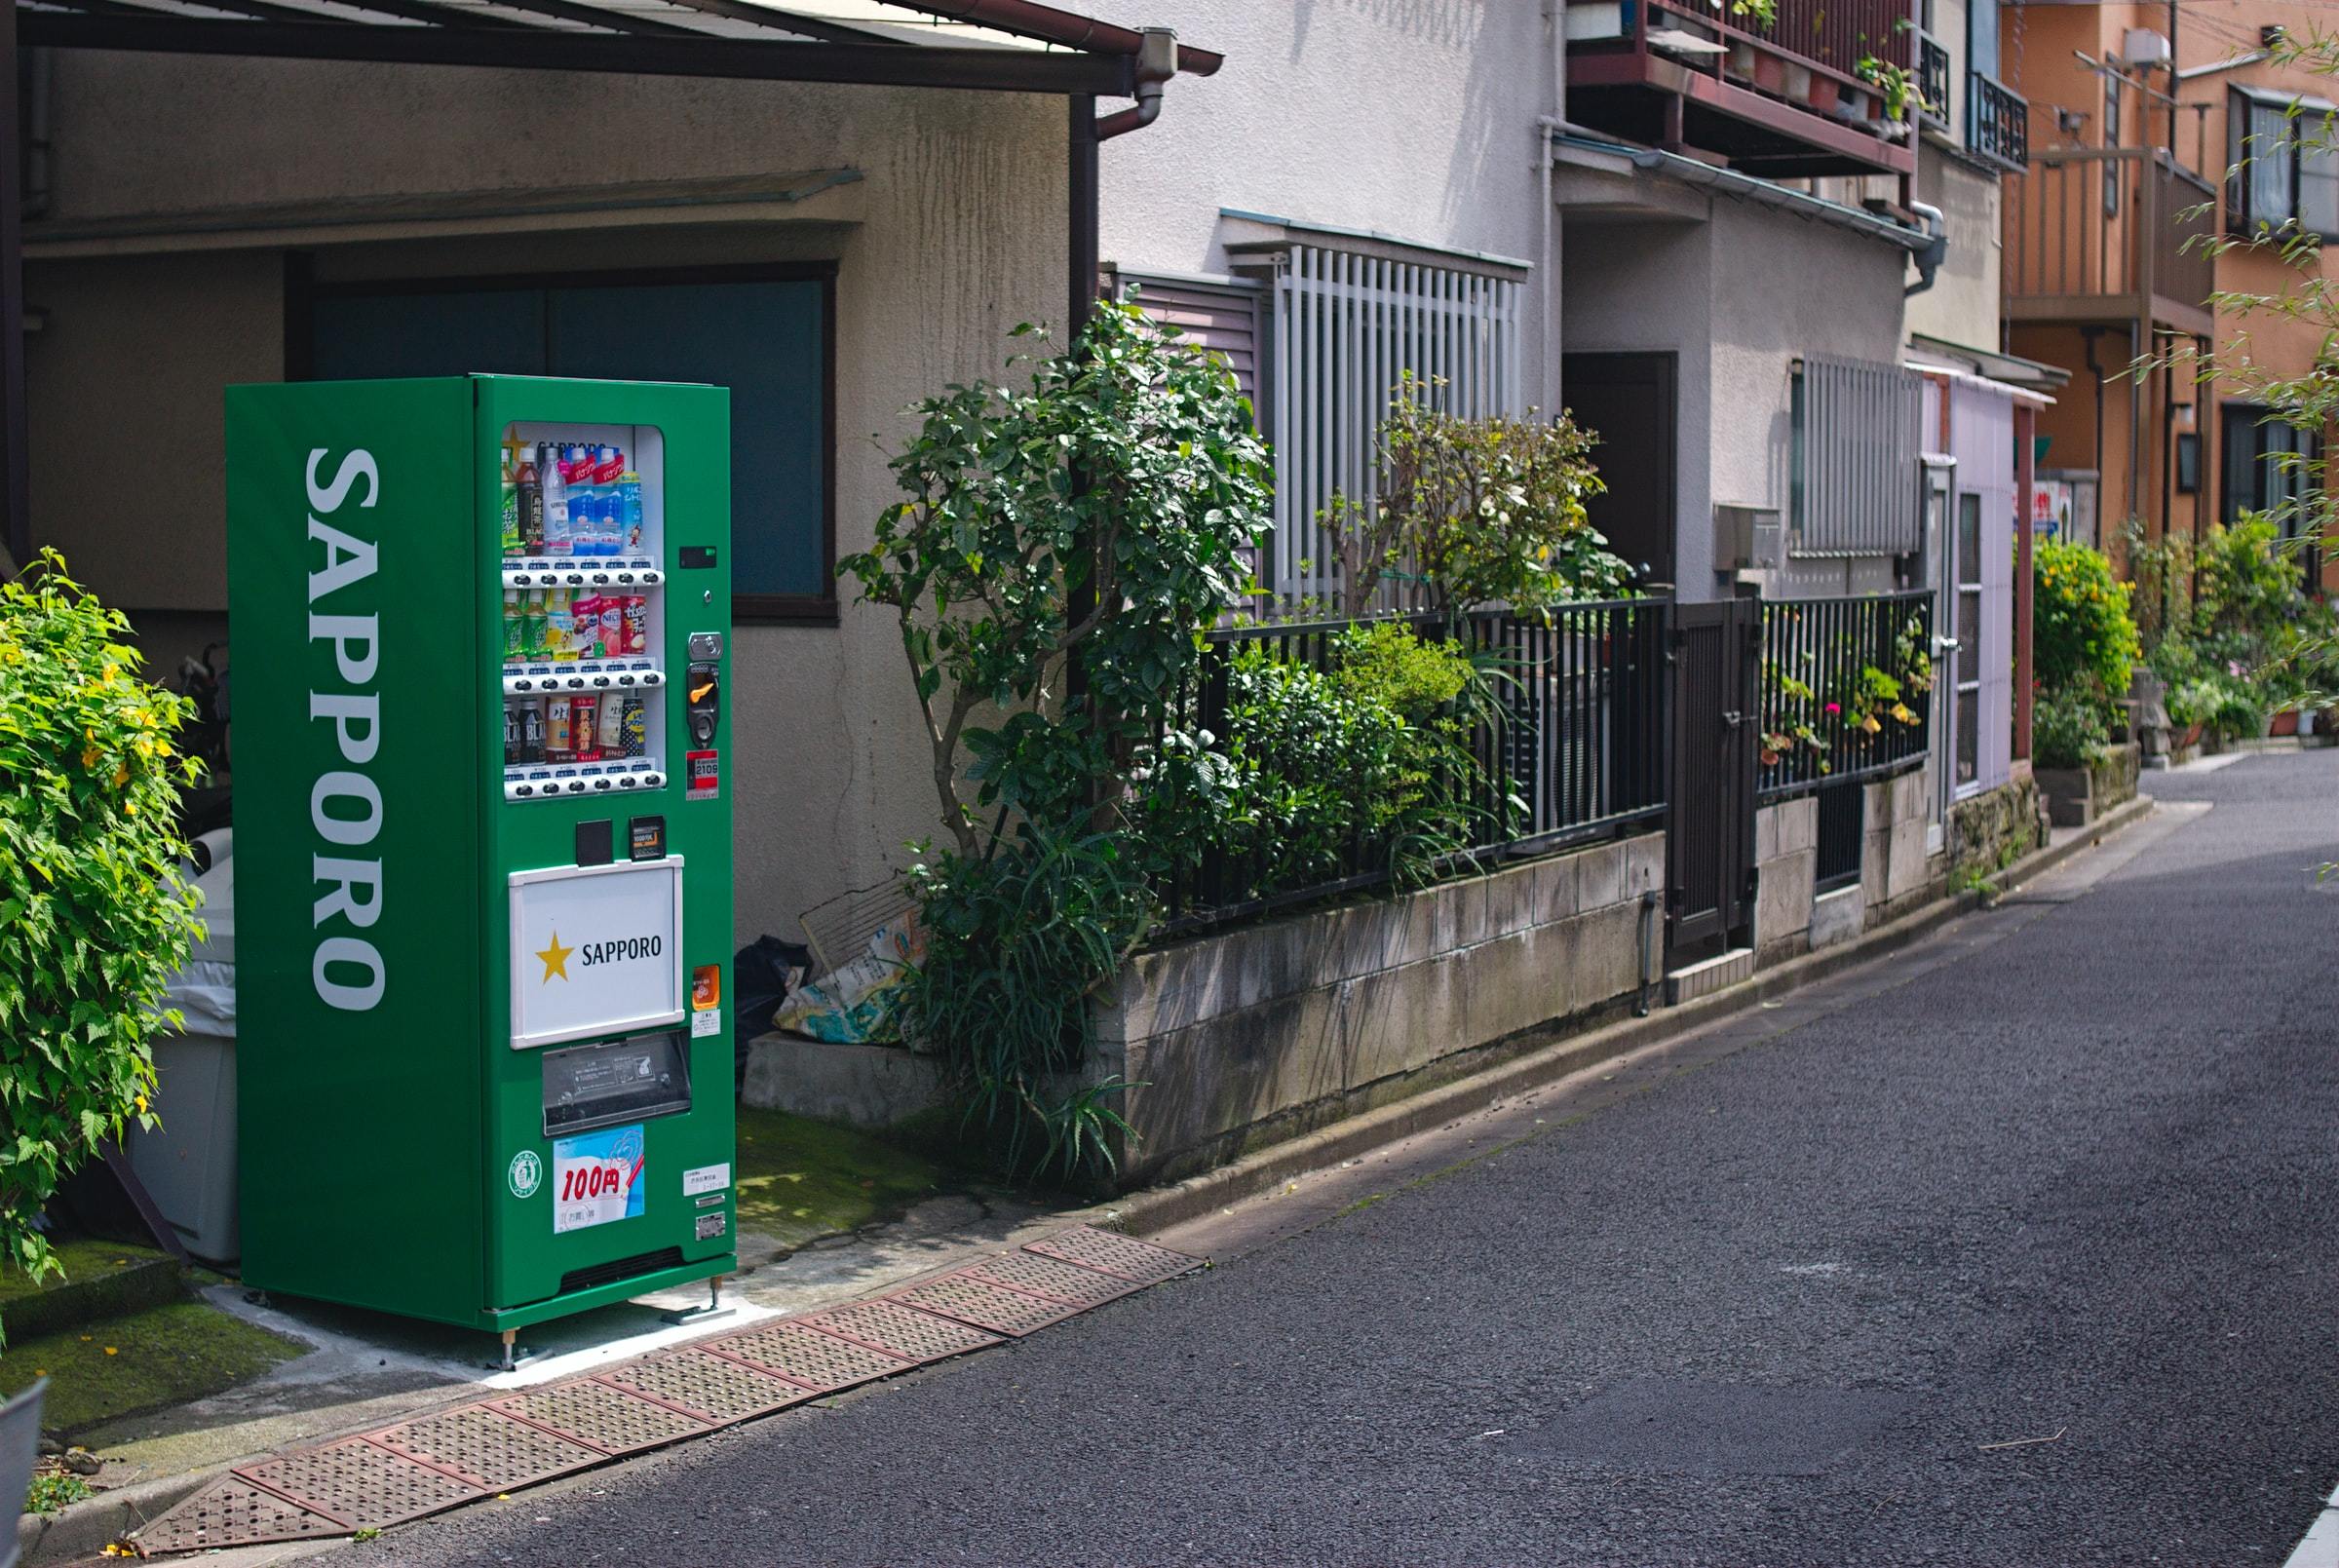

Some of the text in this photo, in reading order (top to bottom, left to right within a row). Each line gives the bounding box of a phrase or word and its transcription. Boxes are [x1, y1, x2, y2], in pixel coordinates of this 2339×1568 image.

[537, 440, 606, 455] SPPOR
[306, 447, 386, 1012] SAPPORO
[696, 764, 718, 775] 2109
[582, 935, 662, 967] SAPPORO
[561, 1165, 620, 1202] 100円
